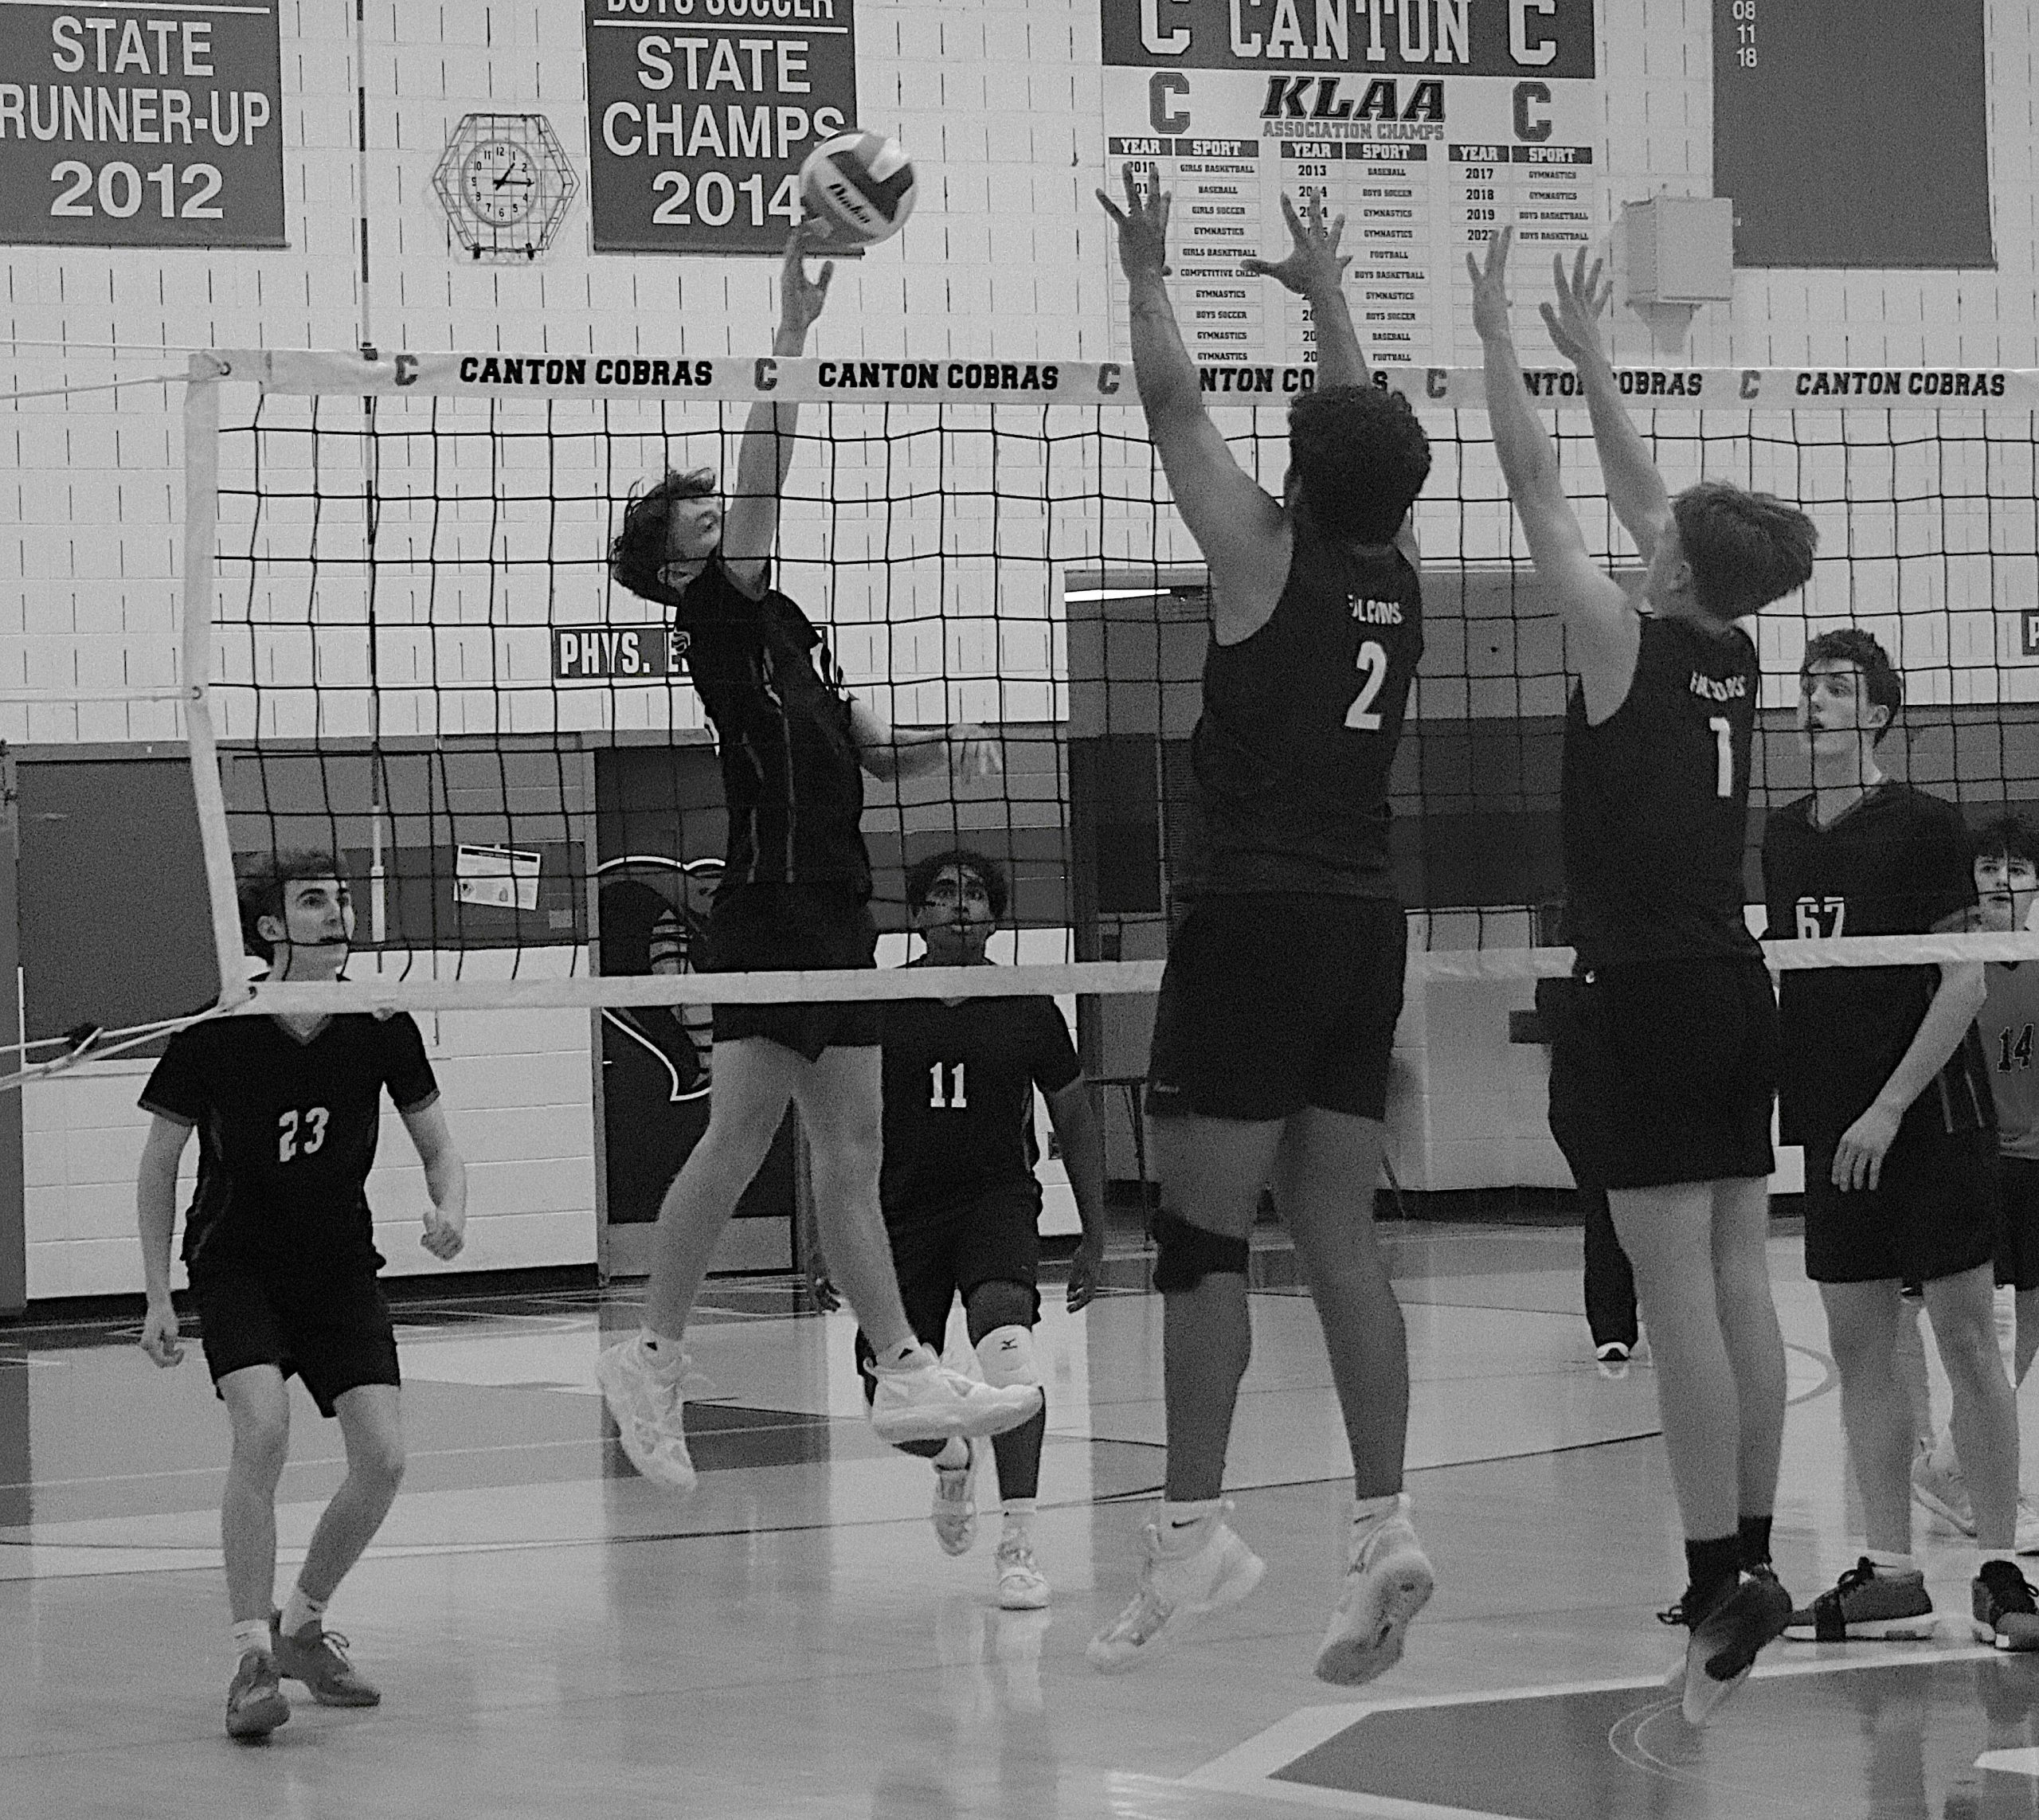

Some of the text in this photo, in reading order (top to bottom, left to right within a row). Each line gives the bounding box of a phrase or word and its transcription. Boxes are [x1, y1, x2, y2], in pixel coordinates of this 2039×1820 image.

[1732, 0, 1756, 20] 08
[1230, 0, 1472, 64] CANTON
[1509, 0, 1556, 65] C
[1736, 24, 1755, 44] 11
[51, 16, 215, 77] STATE
[637, 36, 811, 94] STATE
[1736, 47, 1758, 68] 18
[1149, 72, 1191, 135] C
[1260, 76, 1446, 122] KLAA
[0, 84, 270, 147] RUNNER-UP
[1513, 81, 1552, 143] C
[602, 101, 846, 159] CHAMPS
[1262, 120, 1445, 140] ASSOCIATION CHAMPS
[484, 150, 491, 160] 11
[496, 147, 504, 156] 12
[1120, 138, 1242, 156] YEAR SPORT
[1291, 142, 1411, 159] YEAR SPORT
[1458, 146, 1575, 162] YEAR SPORT
[522, 162, 527, 173] 2
[1204, 164, 1255, 174] BASKETBALL
[1297, 164, 1407, 176] 2013 BASEBALL
[1465, 167, 1577, 179] 2017 GYMNASTICS
[50, 160, 224, 219] 2012
[522, 194, 528, 202] 4
[1198, 186, 1239, 194] BASEBALL
[1298, 186, 1412, 198] 204 BOYS SOCCER
[1466, 189, 1578, 200] 2018 GYMNASTICS
[652, 170, 806, 227] 2014
[486, 202, 491, 213] 7
[499, 208, 504, 217] 6
[512, 204, 518, 213] 5
[1192, 205, 1246, 215] GIRLS SOCCER
[1364, 209, 1412, 217] GYMNASTICS
[1466, 209, 1495, 221] 2019
[1540, 212, 1589, 221] BASKETBALL
[1194, 226, 1245, 236] GYMNASTICS
[1364, 229, 1413, 238] GYMNASTICS
[1541, 232, 1590, 241] BASKETBALL
[1183, 248, 1257, 257] GIRLS BASKETBALL
[1370, 250, 1409, 259] FOOTBALL
[1180, 268, 1233, 277] COMPETITIVE
[1376, 271, 1425, 280] BASKETBALL
[1196, 289, 1246, 299] GYMNASTICS
[1365, 292, 1415, 300] GYMNASTICS
[1196, 311, 1247, 319] BOYS SOCCER
[1197, 331, 1247, 340] GYMNASTICS
[1372, 332, 1411, 341] BASEBALL
[1197, 352, 1248, 361] GYMNASTICS
[1372, 353, 1411, 362] FOOTBALL
[395, 354, 418, 386] C
[460, 357, 713, 386] CANTON COBRAS
[754, 358, 777, 391] C
[818, 362, 1059, 390] CANTON COBRAS
[1097, 362, 1121, 395] C
[1200, 367, 1274, 393] NTON
[1426, 368, 1447, 399] C
[1613, 371, 1703, 396] OBRAS
[1739, 370, 1760, 399] C
[1796, 372, 2006, 397] CANTON COBRAS
[560, 631, 651, 675] PHYS.
[1344, 640, 1387, 730] 2
[1709, 717, 1732, 796] 1
[1795, 897, 1845, 939] 67
[1997, 1024, 2034, 1072] 14
[929, 1062, 967, 1108] 11
[279, 1107, 330, 1162] 23
